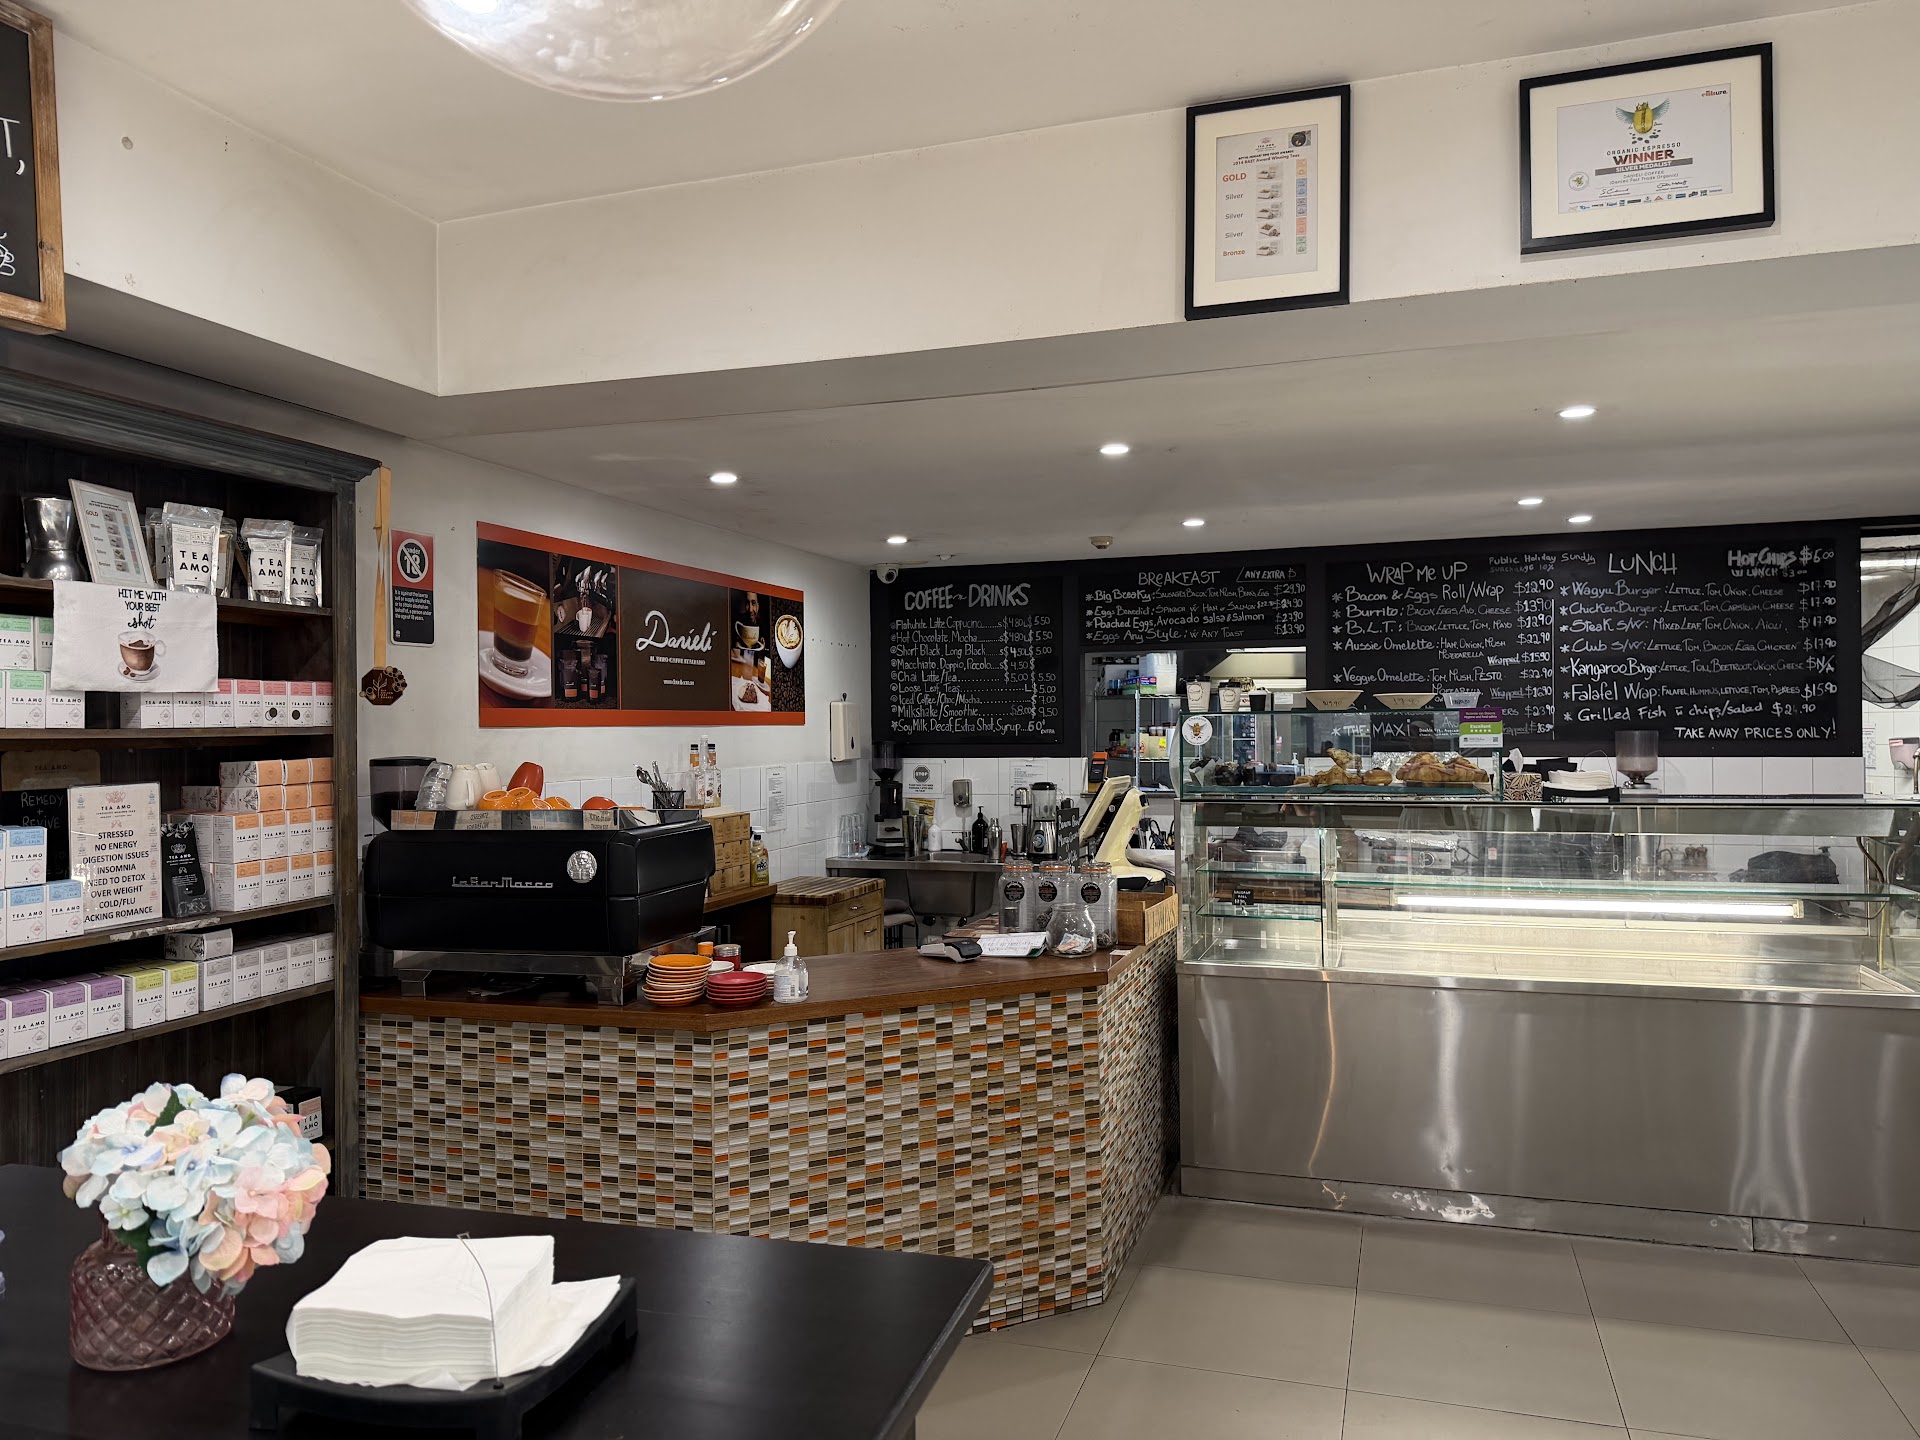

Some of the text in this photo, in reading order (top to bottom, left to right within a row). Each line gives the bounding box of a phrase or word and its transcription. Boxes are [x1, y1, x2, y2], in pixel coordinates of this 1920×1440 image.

[1606, 142, 1681, 156] ORGANIC ESPRESSO
[1613, 149, 1675, 165] WINNER
[1615, 161, 1672, 173] SILVER MEDALIST
[1222, 172, 1247, 183] GOLD
[1225, 231, 1244, 239] Silver
[179, 550, 209, 562] TEA
[258, 557, 283, 567] TEA
[1489, 555, 1520, 565] Public
[1608, 550, 1678, 576] LUNCH
[179, 562, 210, 574] AMO
[291, 566, 314, 577] TEA
[404, 554, 421, 575] 18
[258, 568, 284, 578] AMO
[1244, 570, 1261, 579] ANY
[1261, 570, 1286, 579] EXTRA
[1366, 562, 1414, 585] WRAP
[1442, 561, 1468, 580] UP
[291, 577, 315, 587] AMO
[1571, 581, 1615, 599] Wagyu
[1615, 579, 1662, 599] Burger
[118, 588, 167, 602] HIT ME WITH
[904, 583, 1031, 611] COFFEE DRINKS
[1094, 589, 1113, 604] Big
[1344, 585, 1388, 602] Bacon
[1392, 589, 1404, 600] &
[1404, 587, 1438, 605] Eggs
[124, 600, 161, 612] YOUR BEST
[1616, 600, 1658, 617] Burger
[127, 611, 157, 629] shot
[1092, 616, 1131, 629] Poached
[1156, 612, 1200, 626] Avocado
[1202, 612, 1226, 624] salsa
[1231, 611, 1265, 622] Salmon
[896, 632, 910, 643] Hot
[1092, 630, 1120, 644] Eggs
[1123, 629, 1144, 644] Any
[1146, 627, 1182, 642] Style
[1201, 629, 1219, 638] ANY
[1344, 638, 1382, 651] Aussie
[1383, 636, 1435, 651] Omelette
[1571, 637, 1608, 653] Club
[896, 643, 963, 660] Short Long
[1438, 649, 1521, 667] MOZZARELLA Wrapped
[897, 671, 917, 682] Chai
[1342, 666, 1377, 685] Veggie
[1377, 667, 1426, 682] Omelette
[1570, 657, 1627, 682] Kangaroo
[898, 683, 922, 693] Loose
[1489, 687, 1525, 701] Wrapped
[1571, 681, 1618, 702] Falafel
[899, 694, 916, 705] Iced
[1577, 706, 1631, 722] Grilled
[1637, 704, 1667, 720] Fish
[897, 716, 976, 735] Soy Extra
[1673, 717, 1837, 740] TAKE AWAY PRICES ONLY!
[20, 791, 64, 808] REMEDY
[97, 829, 134, 840] STRESSED
[94, 840, 138, 852] NO ENERGY
[82, 850, 150, 865] DIGESTION ISSUES
[97, 863, 137, 875] INSOMNIA
[89, 873, 146, 887] NEED TO DETOX
[90, 884, 143, 899] OVER WEIGHT
[98, 898, 136, 909] COLD/FLU
[84, 906, 153, 923] ACKING ROMANCE
[70, 1010, 85, 1018] AMO
[304, 1114, 318, 1123] TEA
[303, 1121, 319, 1131] AMO
